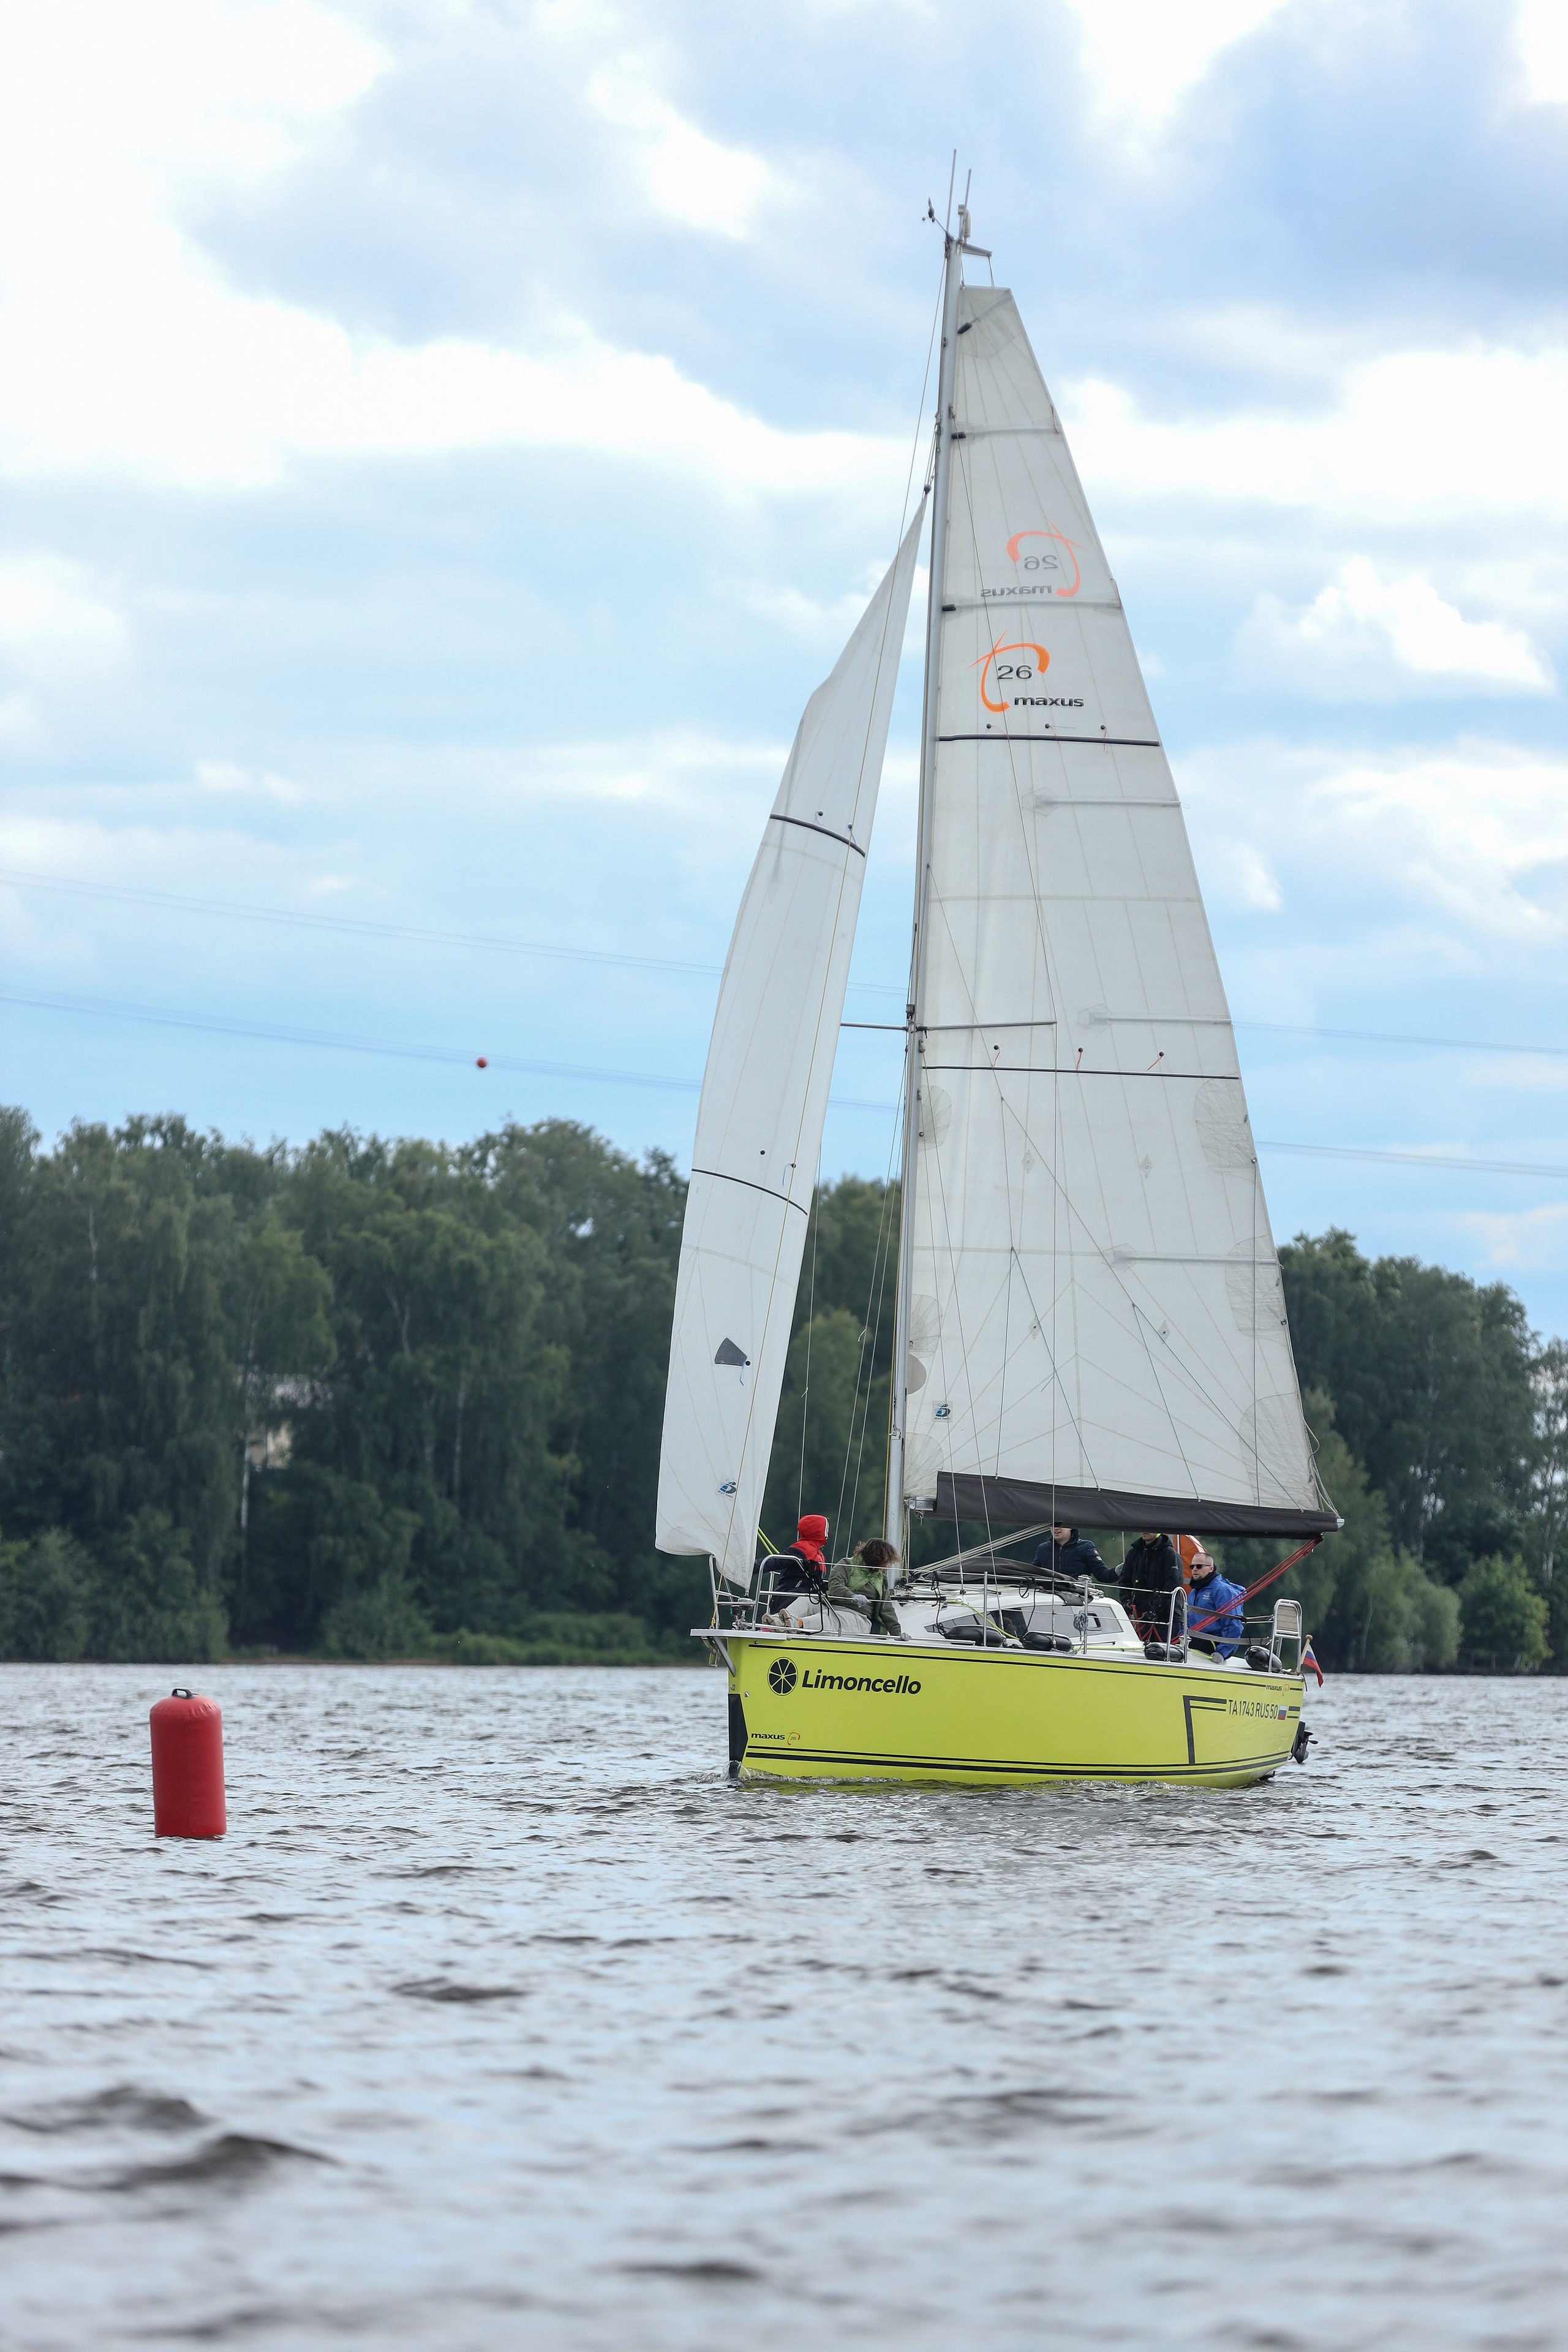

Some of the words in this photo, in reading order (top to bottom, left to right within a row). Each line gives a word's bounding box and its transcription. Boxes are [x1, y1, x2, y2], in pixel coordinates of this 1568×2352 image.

[997, 665, 1033, 679] 26
[1014, 696, 1085, 707] maxus
[802, 1669, 921, 1694] Limoncello
[1229, 1700, 1237, 1715] TA
[1239, 1700, 1254, 1716] 1743
[1255, 1702, 1270, 1719] RUS
[1270, 1704, 1278, 1719] 50
